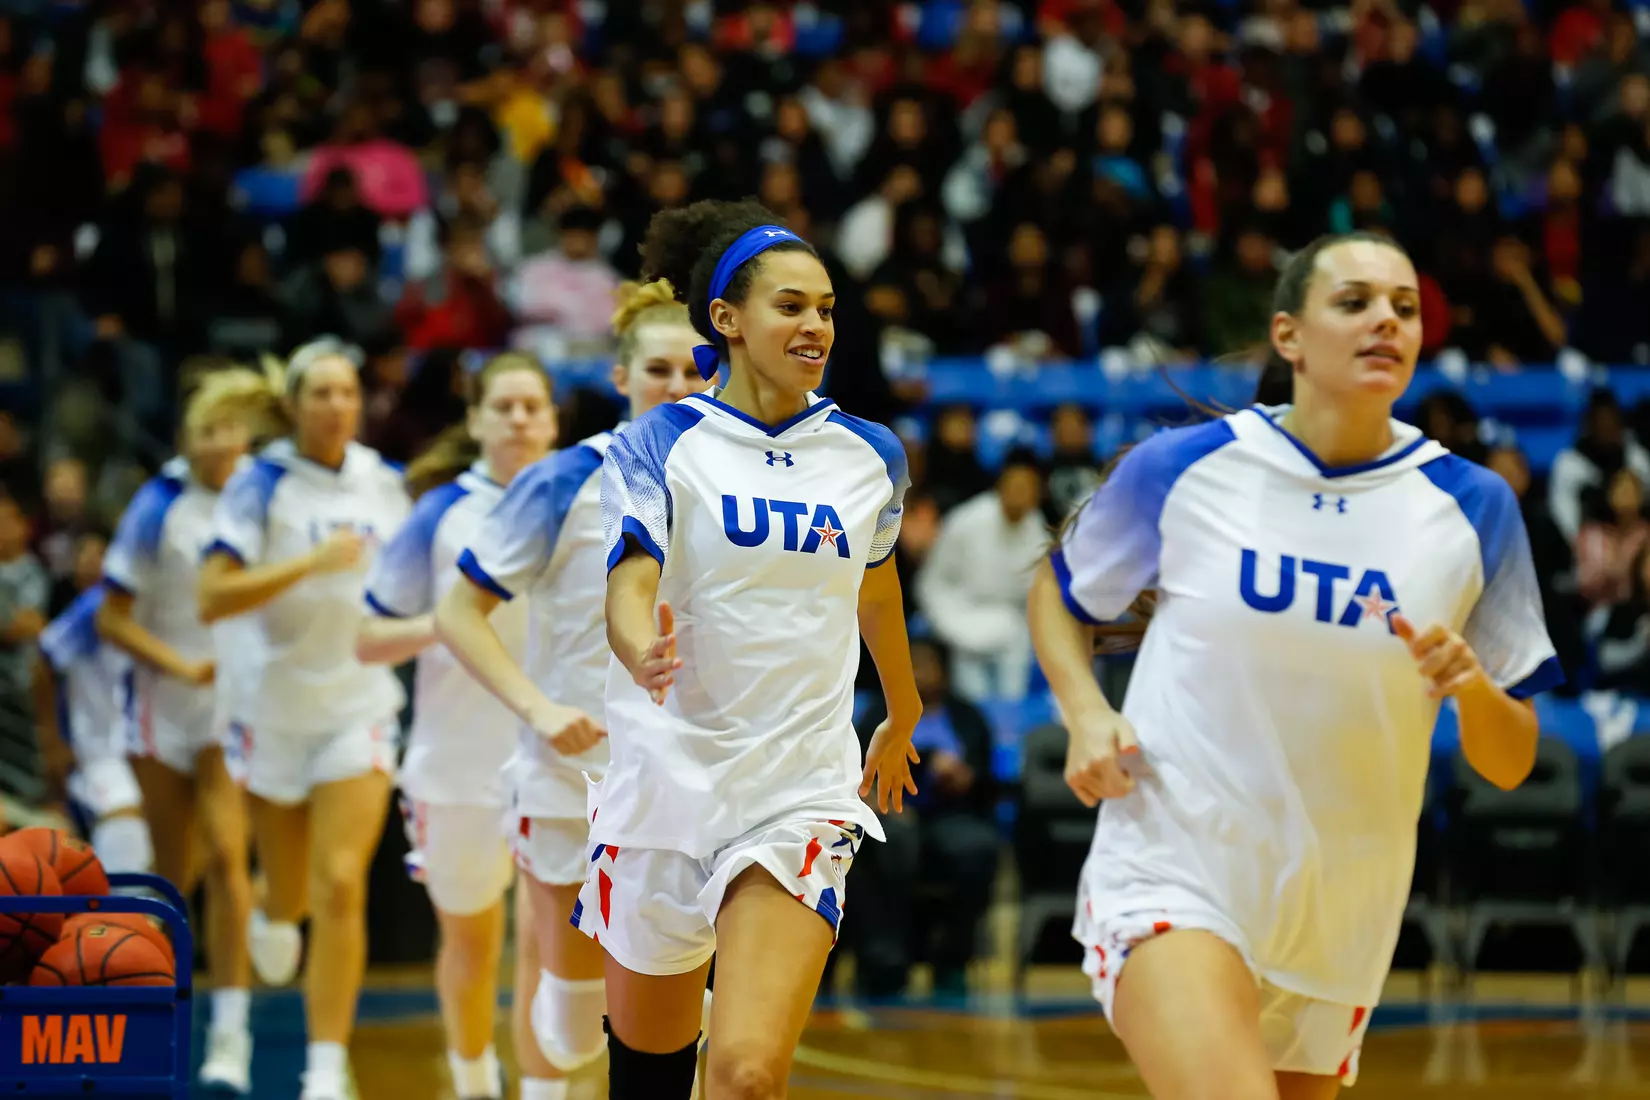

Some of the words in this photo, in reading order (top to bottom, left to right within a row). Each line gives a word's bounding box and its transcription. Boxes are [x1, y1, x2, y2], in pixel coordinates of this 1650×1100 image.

[721, 494, 850, 559] UTA
[1239, 548, 1399, 635] UTA
[21, 1014, 127, 1064] MAV
